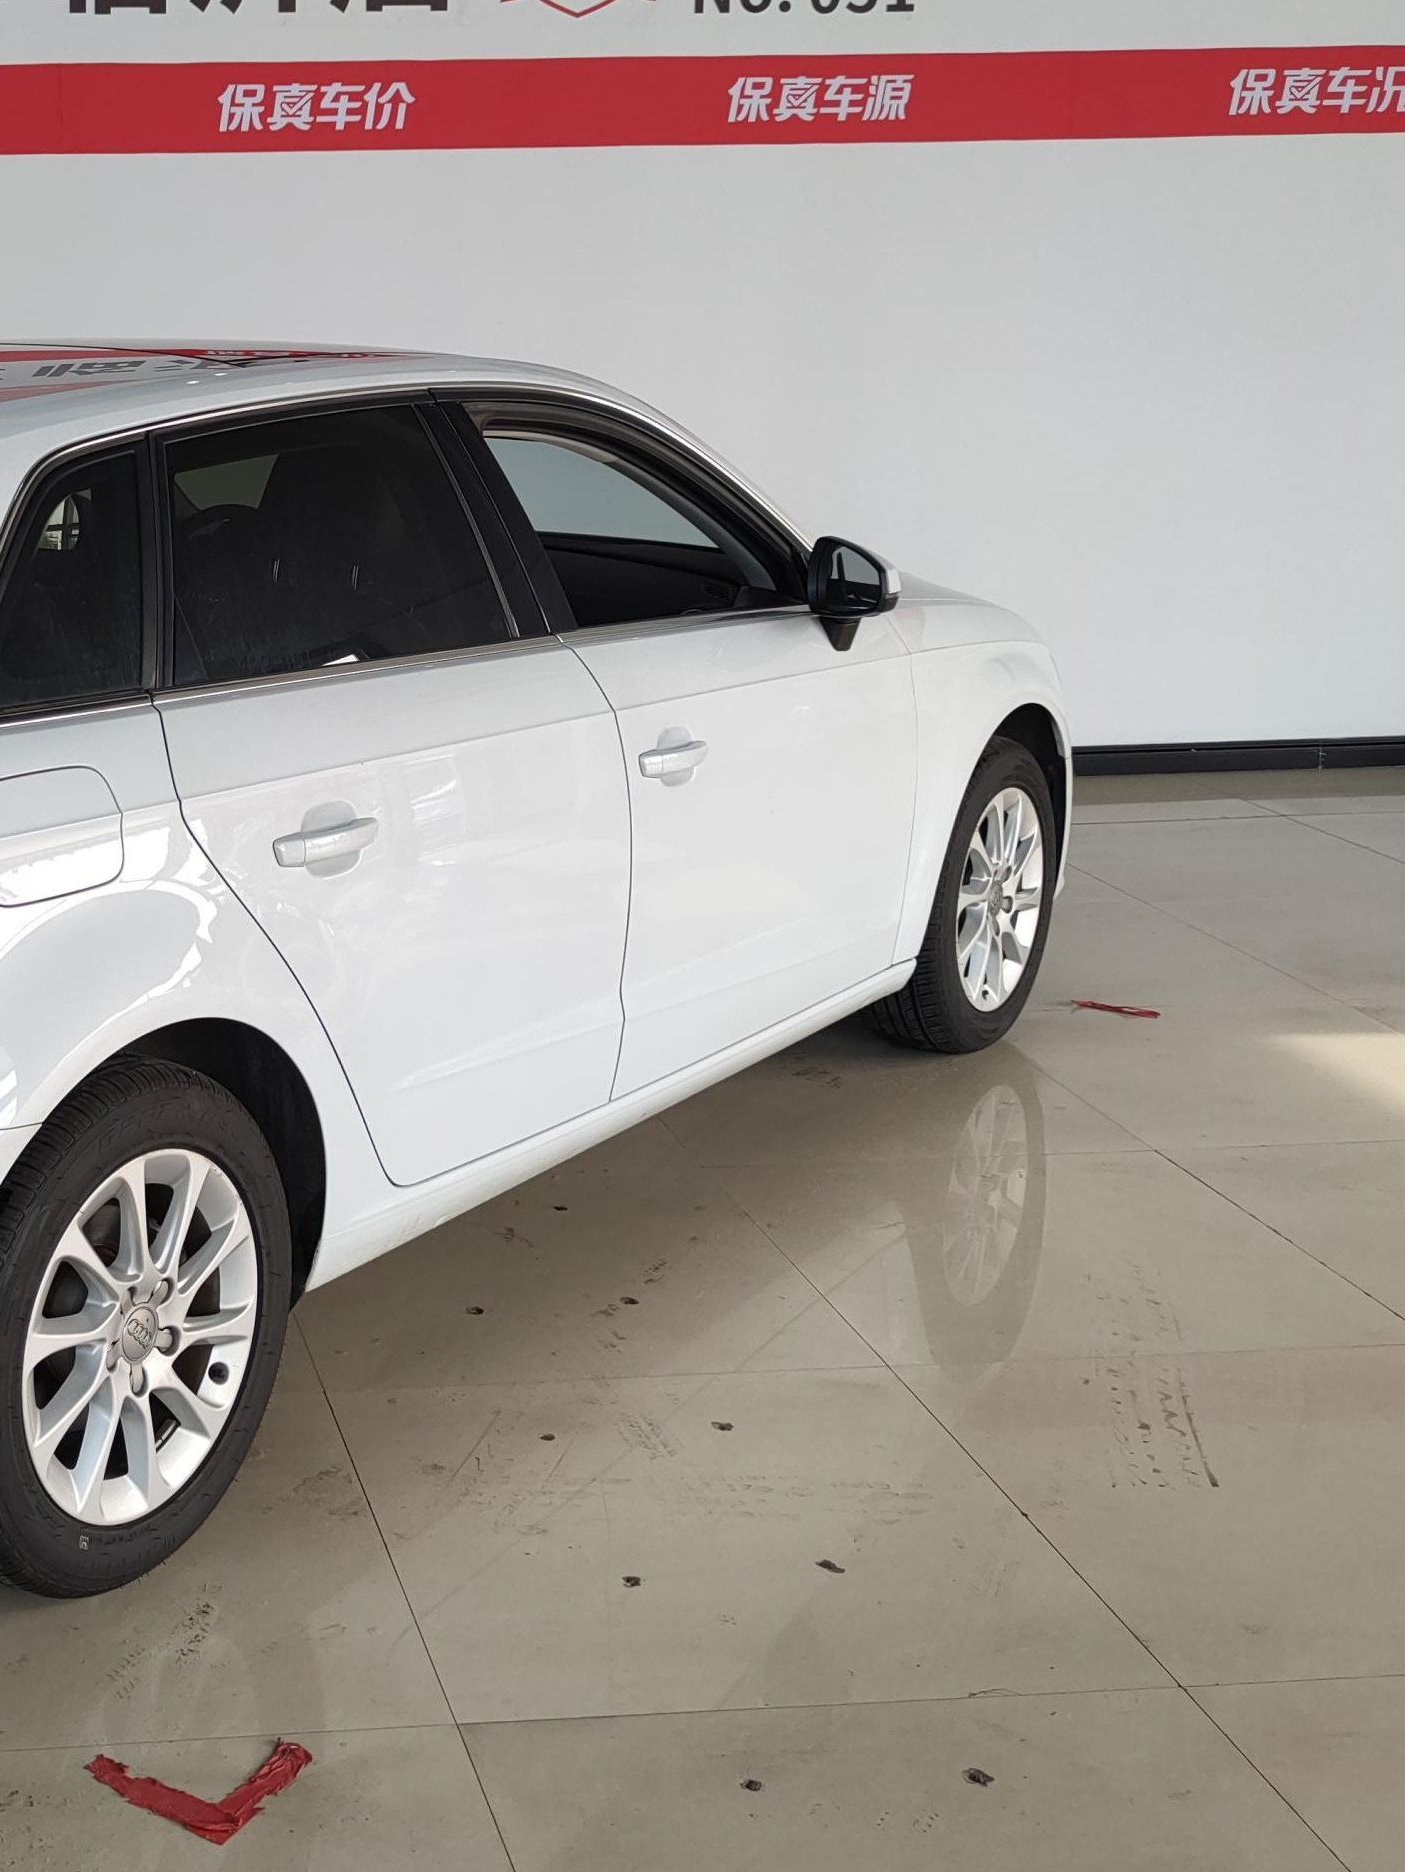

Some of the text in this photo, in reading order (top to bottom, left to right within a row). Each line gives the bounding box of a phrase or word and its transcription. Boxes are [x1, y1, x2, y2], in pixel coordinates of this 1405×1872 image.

[218, 82, 415, 132] 保真车价
[728, 75, 914, 122] 保真车源
